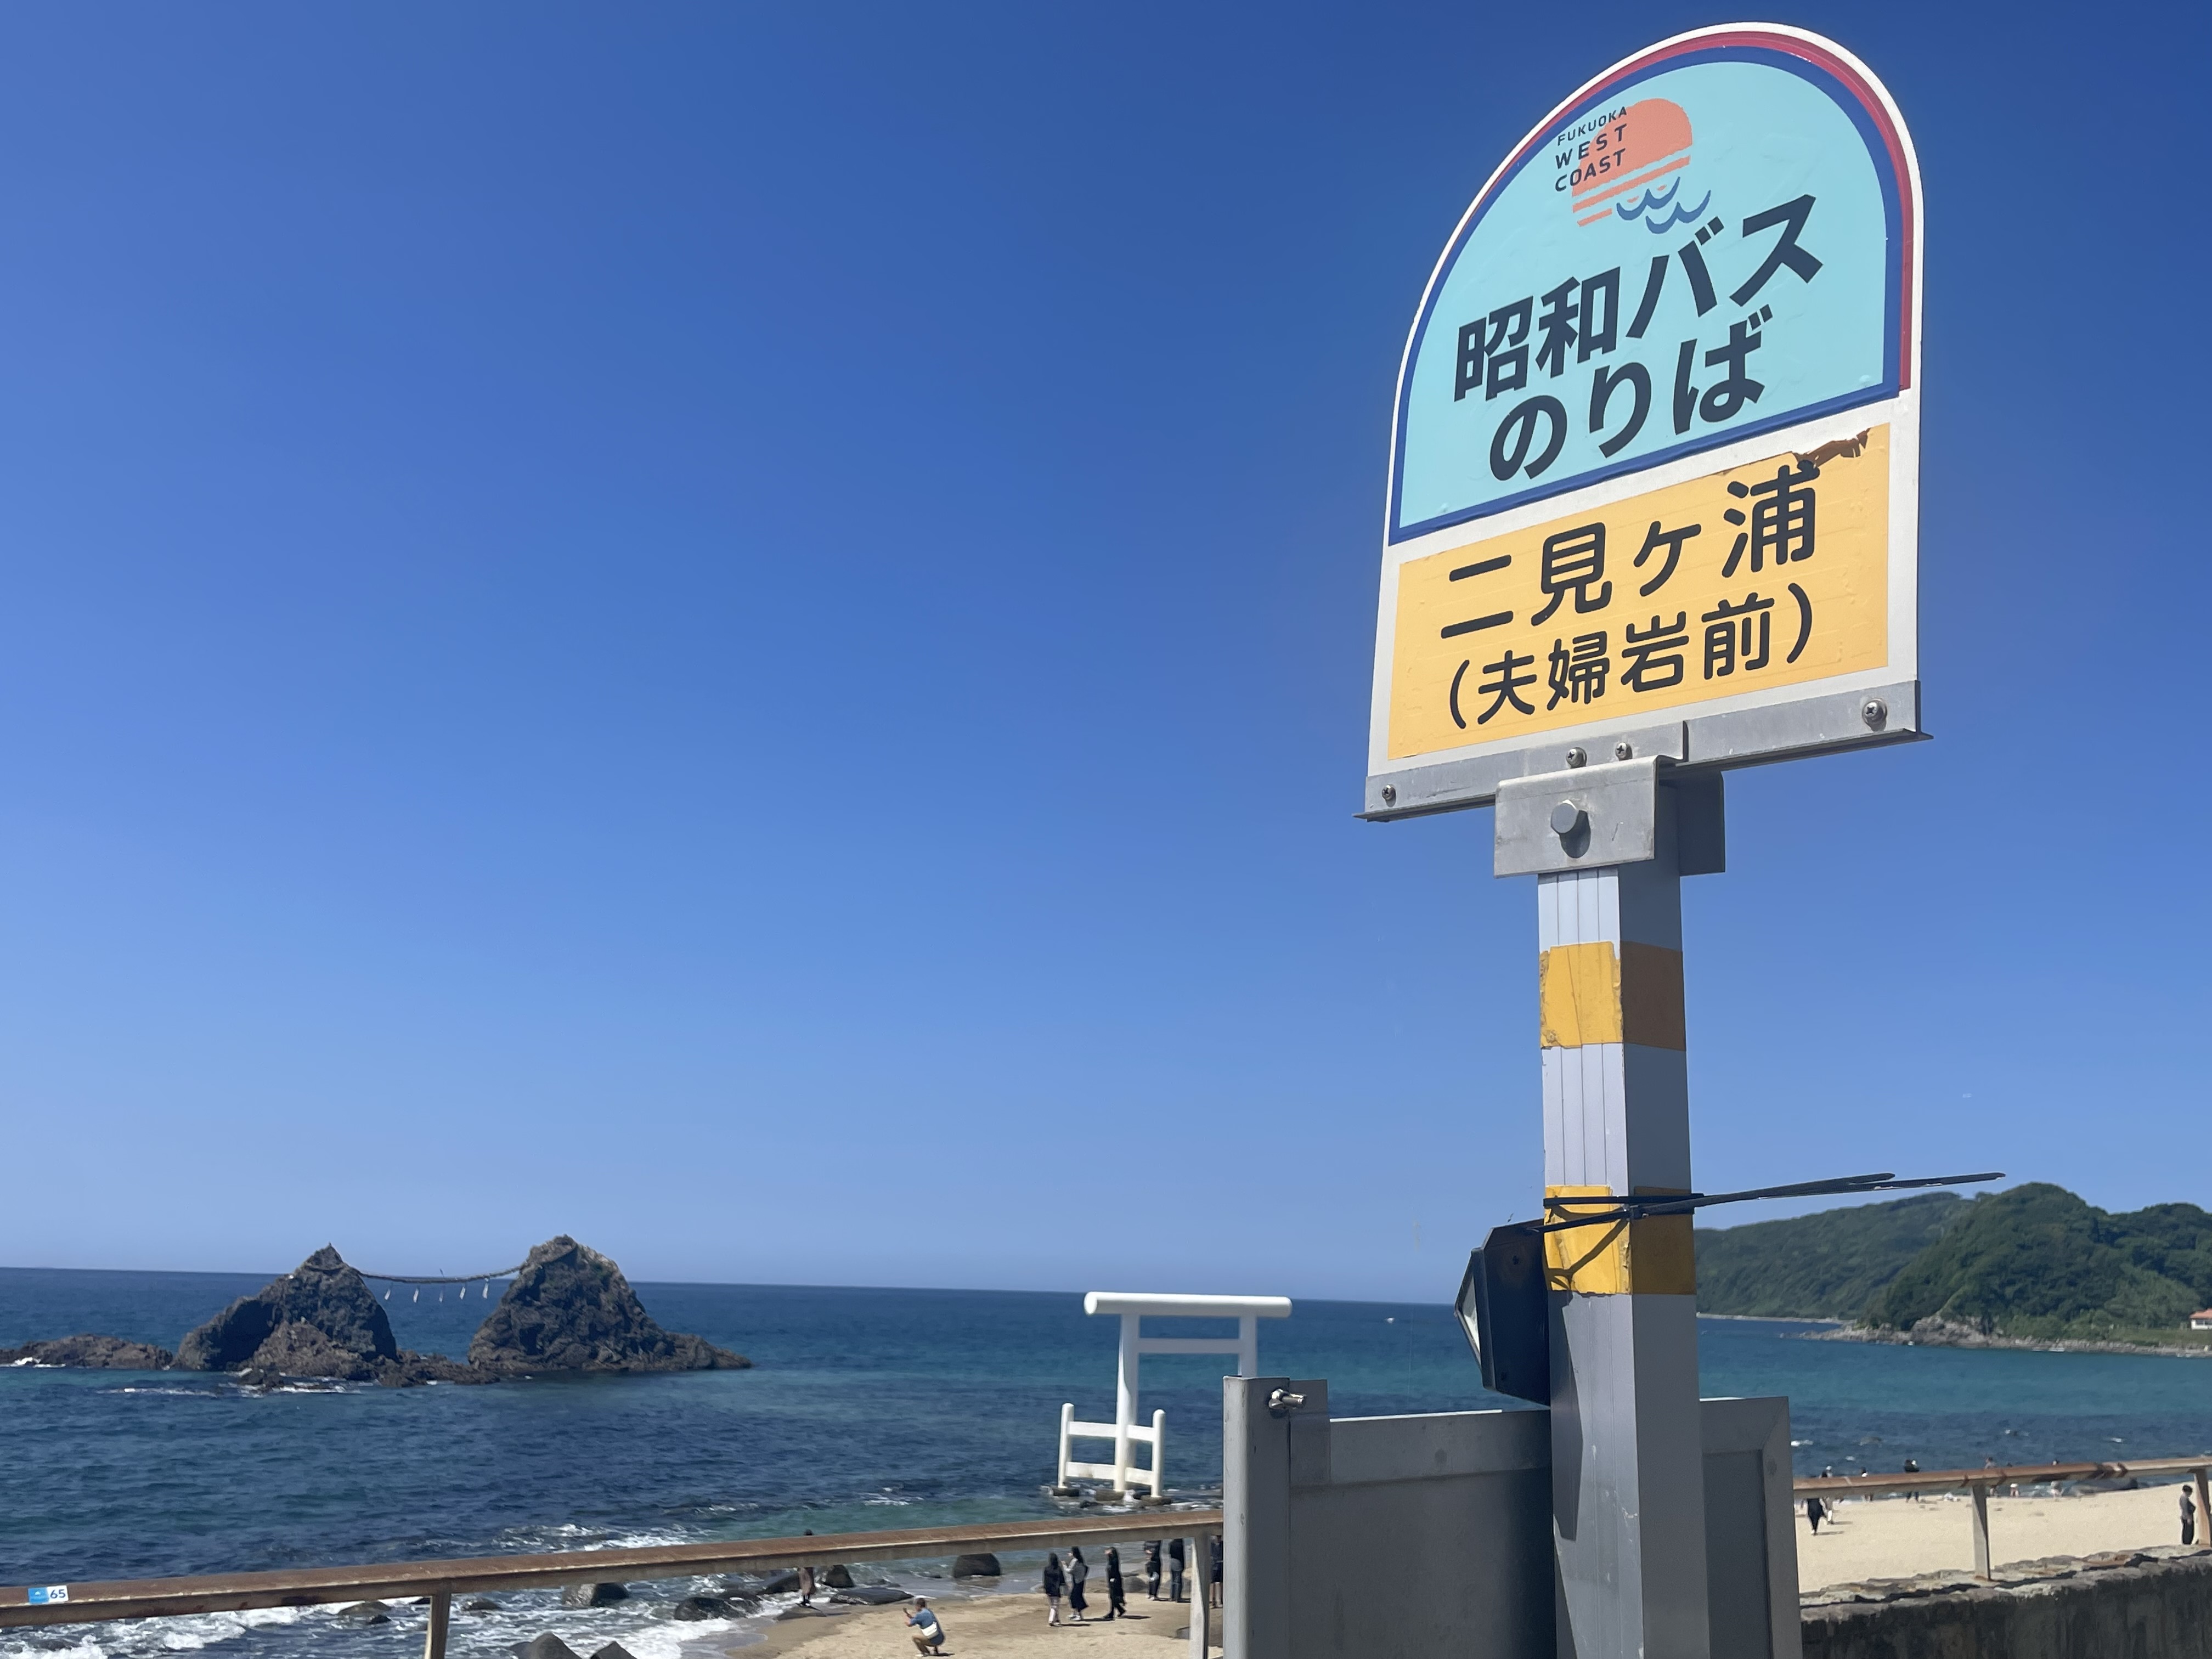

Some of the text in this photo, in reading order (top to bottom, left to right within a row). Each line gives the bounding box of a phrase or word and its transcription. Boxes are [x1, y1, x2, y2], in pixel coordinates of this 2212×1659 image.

[1555, 123, 1627, 169] WEST
[1557, 106, 1627, 146] FUKUOKA
[1555, 148, 1626, 191] COAST
[1454, 194, 1824, 402] 昭和バス
[1489, 304, 1773, 481] のりば
[50, 1589, 66, 1599] 65
